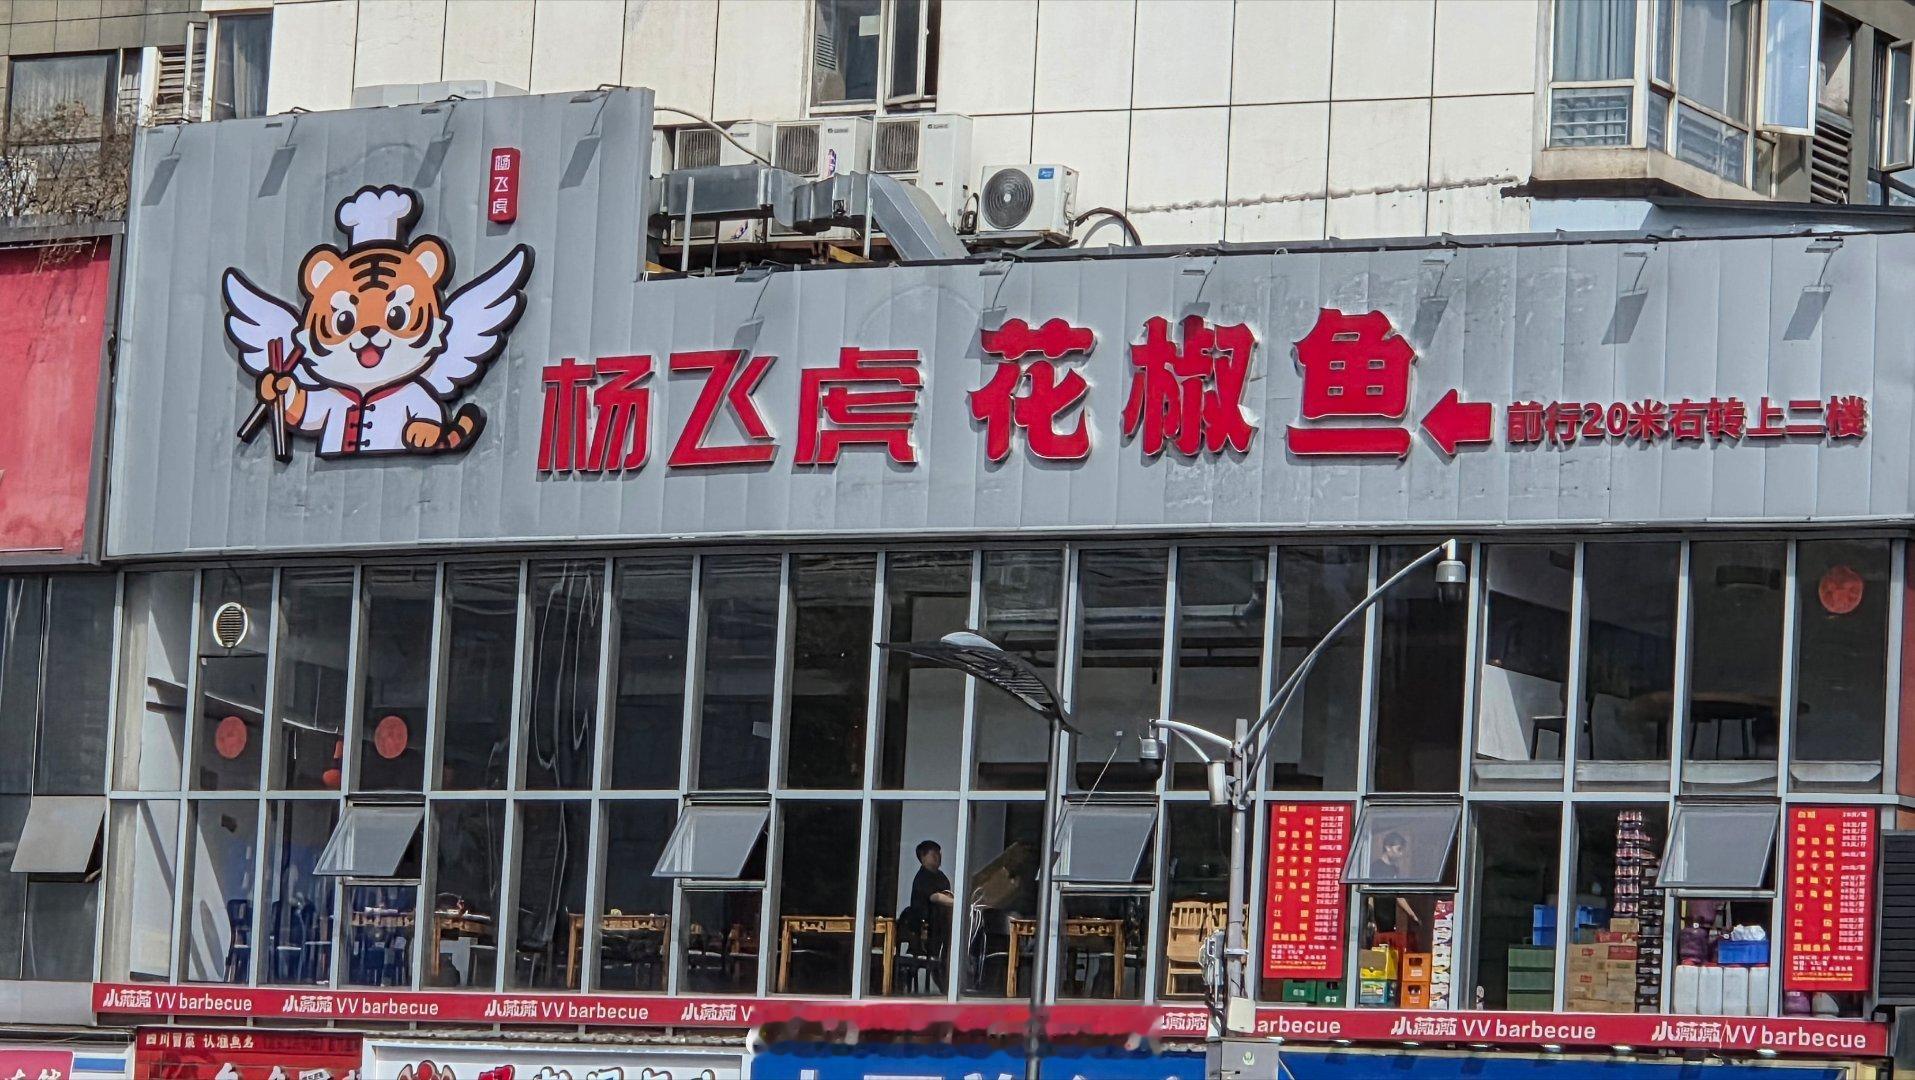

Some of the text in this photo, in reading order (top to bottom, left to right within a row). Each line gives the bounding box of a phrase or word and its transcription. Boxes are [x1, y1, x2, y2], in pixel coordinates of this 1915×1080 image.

[493, 154, 511, 214] 杨飞虎
[537, 307, 1418, 473] 杨飞虎花椒鱼
[1506, 396, 1868, 442] 前行20米右转上二楼
[155, 992, 176, 1009] VV
[179, 992, 253, 1011] barbecue
[336, 997, 359, 1014] VV
[362, 998, 439, 1015] barbecue
[541, 1001, 565, 1018] VV
[568, 1001, 649, 1020] barbecue
[1461, 1019, 1491, 1037] VV
[1496, 1019, 1596, 1039] barbecue
[1724, 1025, 1756, 1044] VV
[1761, 1025, 1866, 1048] barbecue
